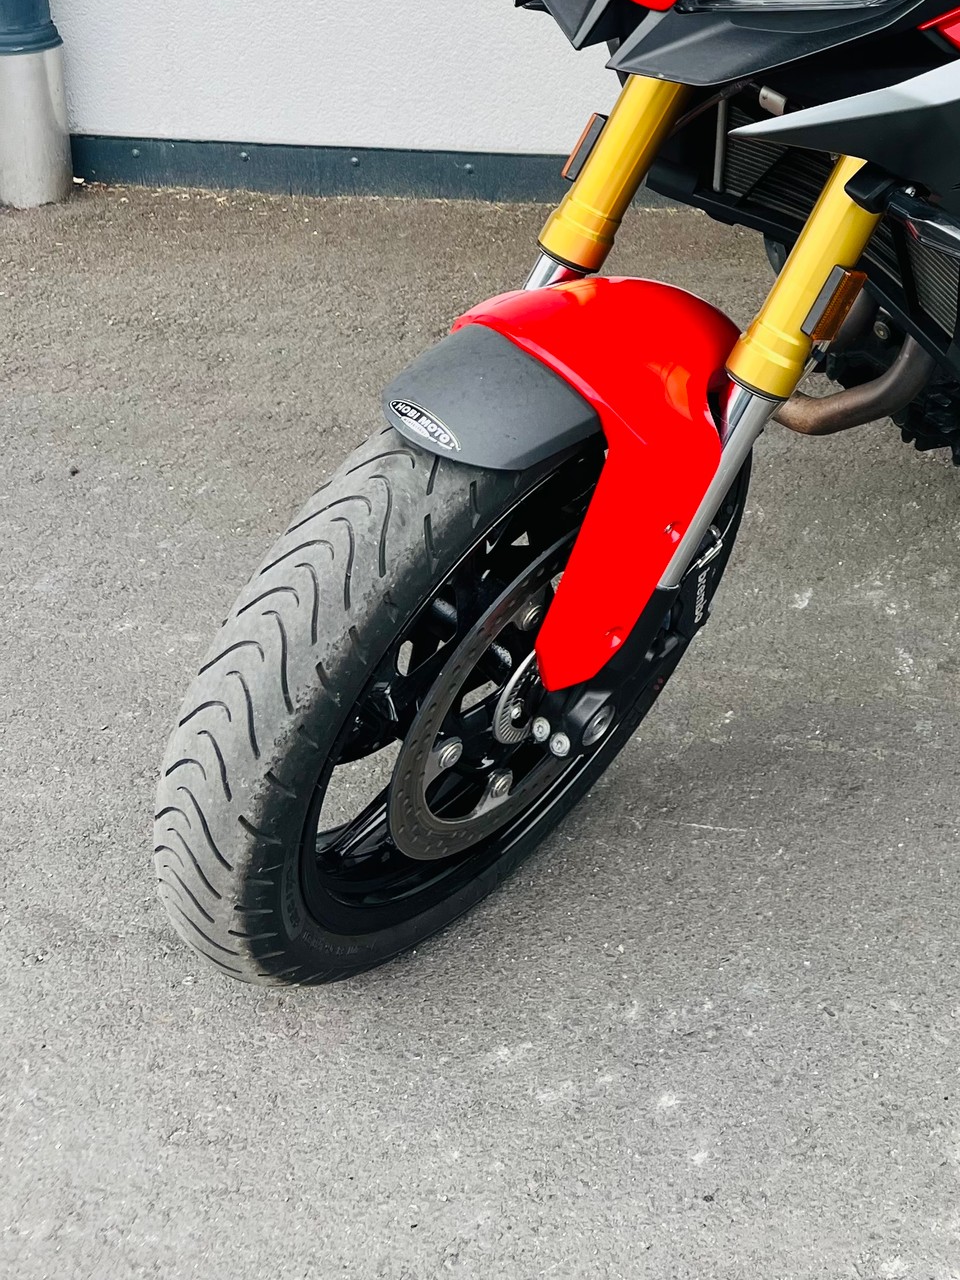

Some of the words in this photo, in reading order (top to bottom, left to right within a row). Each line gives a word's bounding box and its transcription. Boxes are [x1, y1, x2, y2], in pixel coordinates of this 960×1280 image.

[394, 402, 421, 420] HOBI
[417, 416, 451, 444] MOTO
[694, 566, 711, 624] brembo
